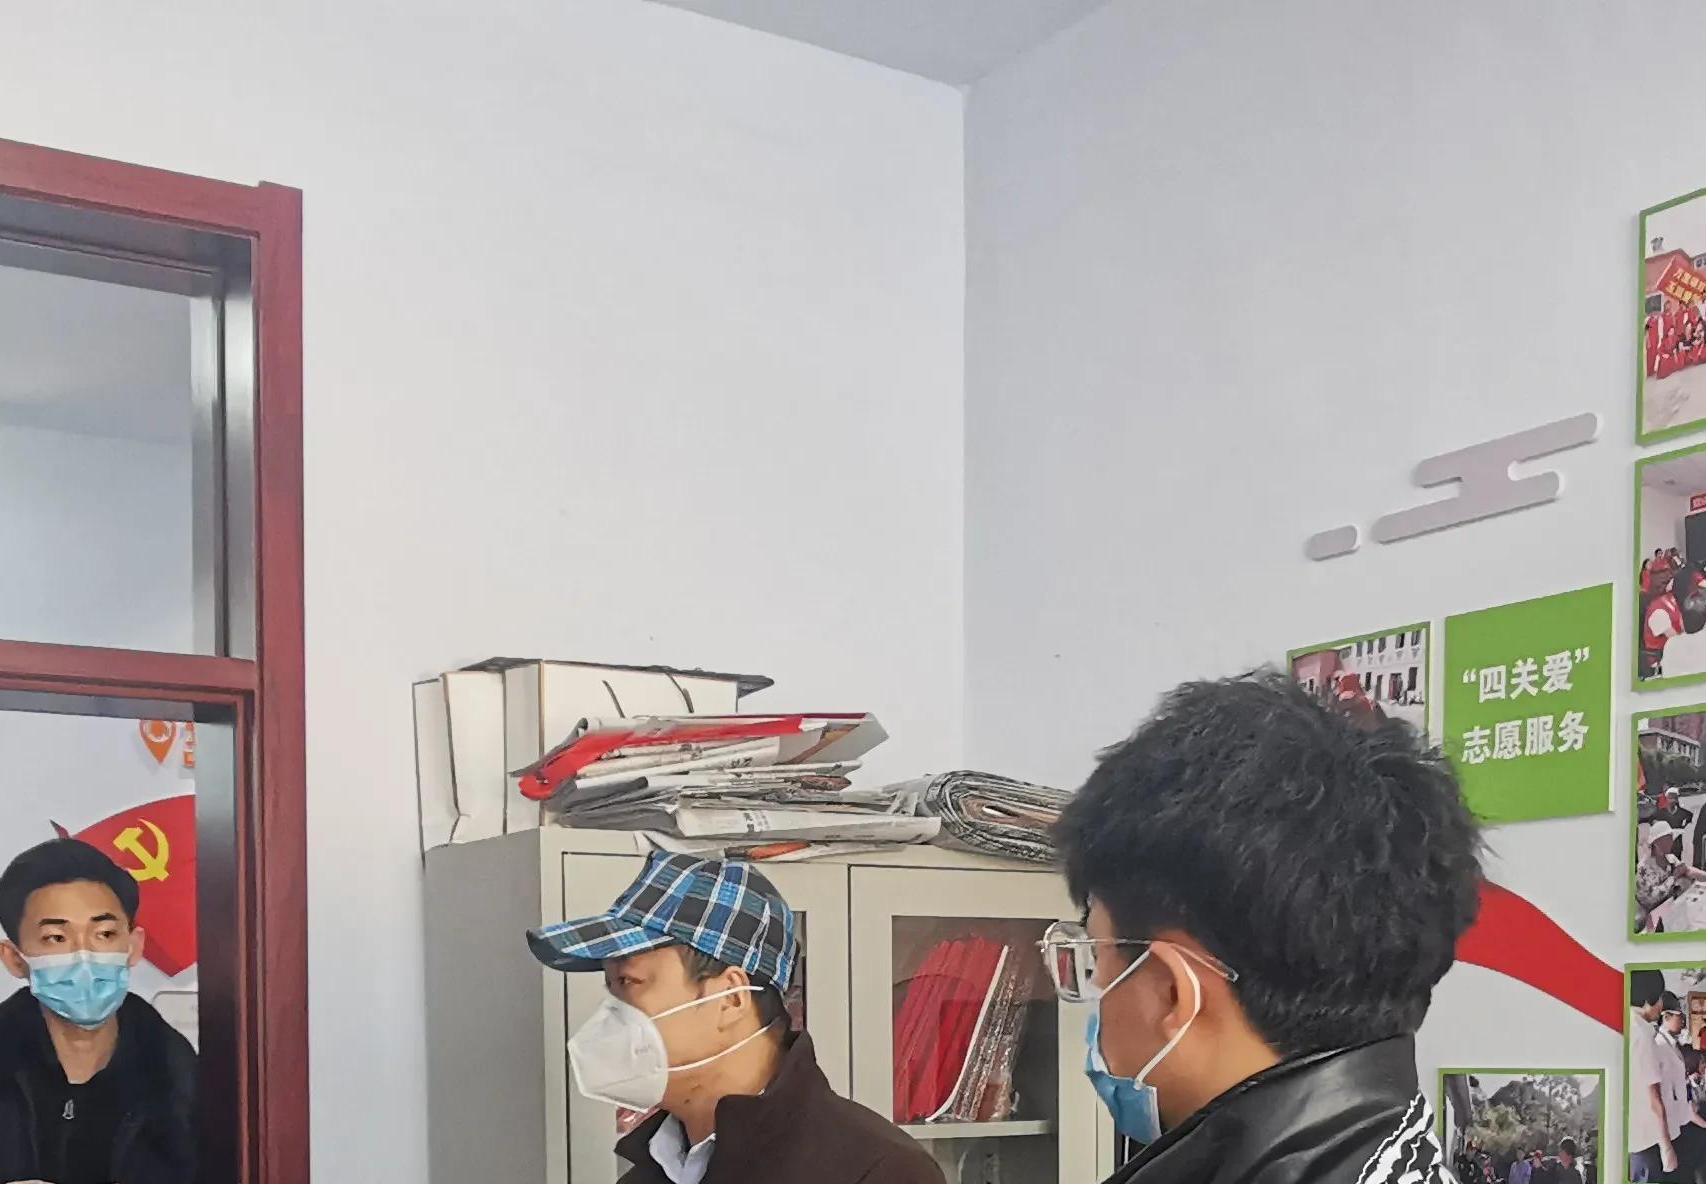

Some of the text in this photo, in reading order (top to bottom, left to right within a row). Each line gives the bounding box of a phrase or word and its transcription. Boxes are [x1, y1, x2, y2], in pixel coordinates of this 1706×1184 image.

[1461, 645, 1590, 704] “四关爱”
[1460, 710, 1590, 765] 志愿服务
